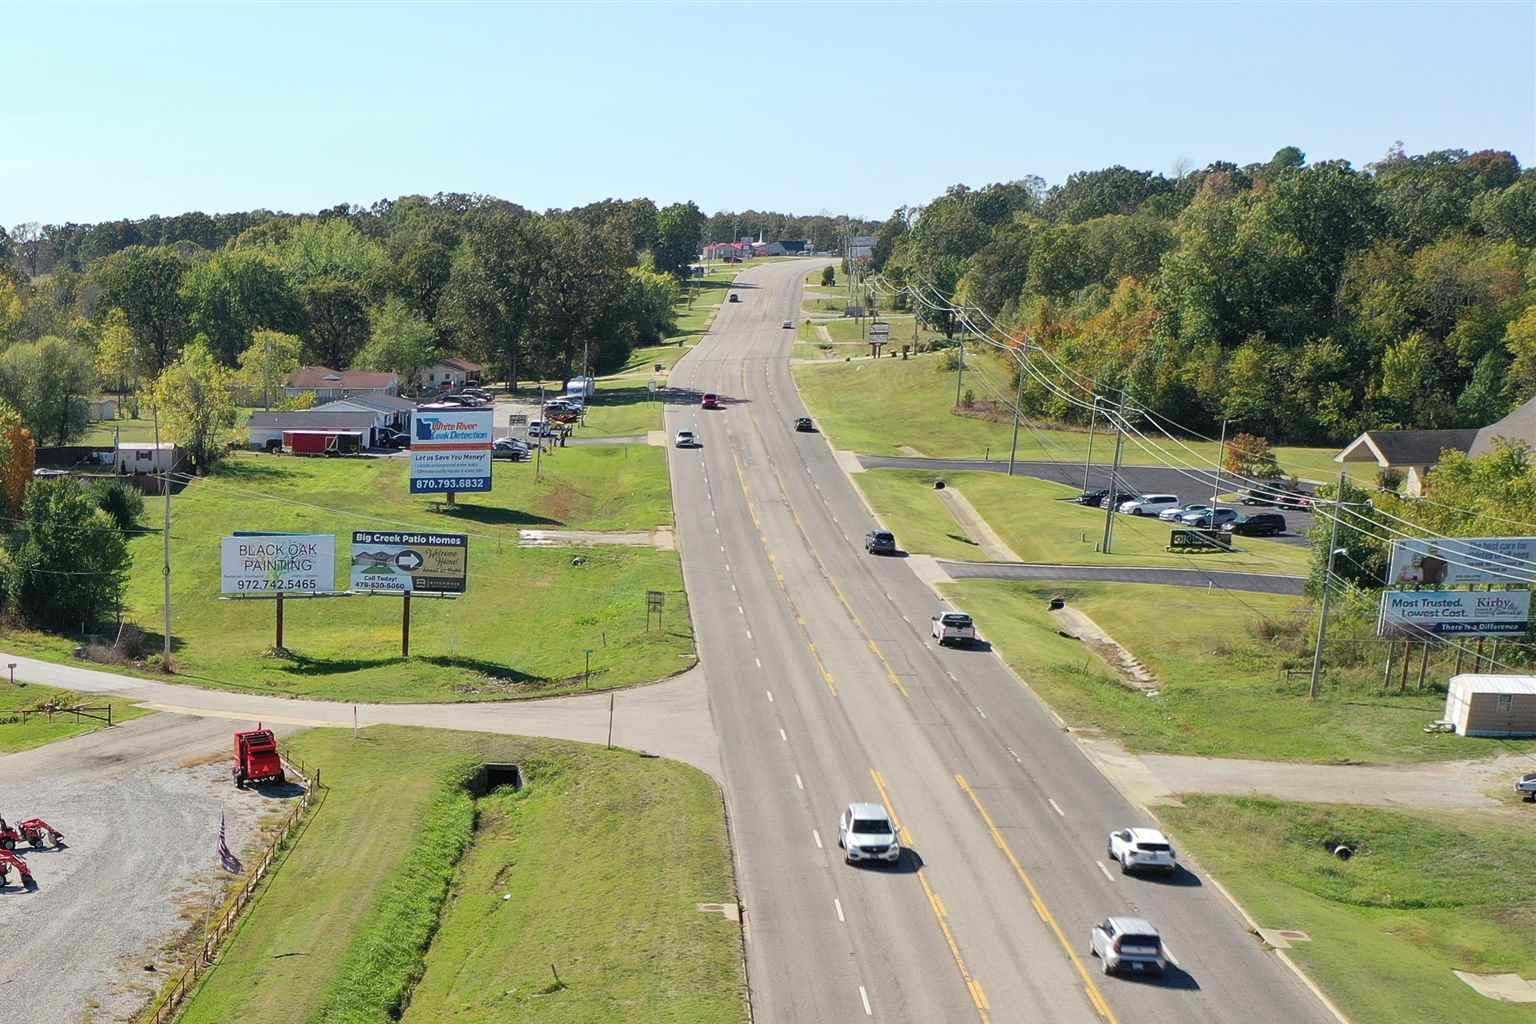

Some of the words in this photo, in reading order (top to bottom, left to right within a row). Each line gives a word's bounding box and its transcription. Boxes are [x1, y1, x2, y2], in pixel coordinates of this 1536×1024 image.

[455, 422, 478, 431] River
[449, 431, 488, 439] Detection
[463, 454, 486, 462] Money!
[416, 479, 484, 488] 870.793.6832
[356, 533, 372, 542] Big
[374, 534, 401, 542] Creek
[402, 535, 427, 543] Patio
[429, 535, 461, 544] Homes
[239, 544, 284, 556] BLACK
[288, 543, 318, 556] OAK
[244, 559, 312, 571] PAINTING
[238, 579, 317, 590] 972.742.5465
[1392, 598, 1419, 608] Most
[1421, 598, 1463, 608] Trusted.
[1477, 597, 1511, 610] Kirby
[1401, 609, 1440, 617] Lowest
[1441, 608, 1468, 617] Cost.
[1442, 623, 1462, 631] There
[1478, 623, 1519, 631] Difference
